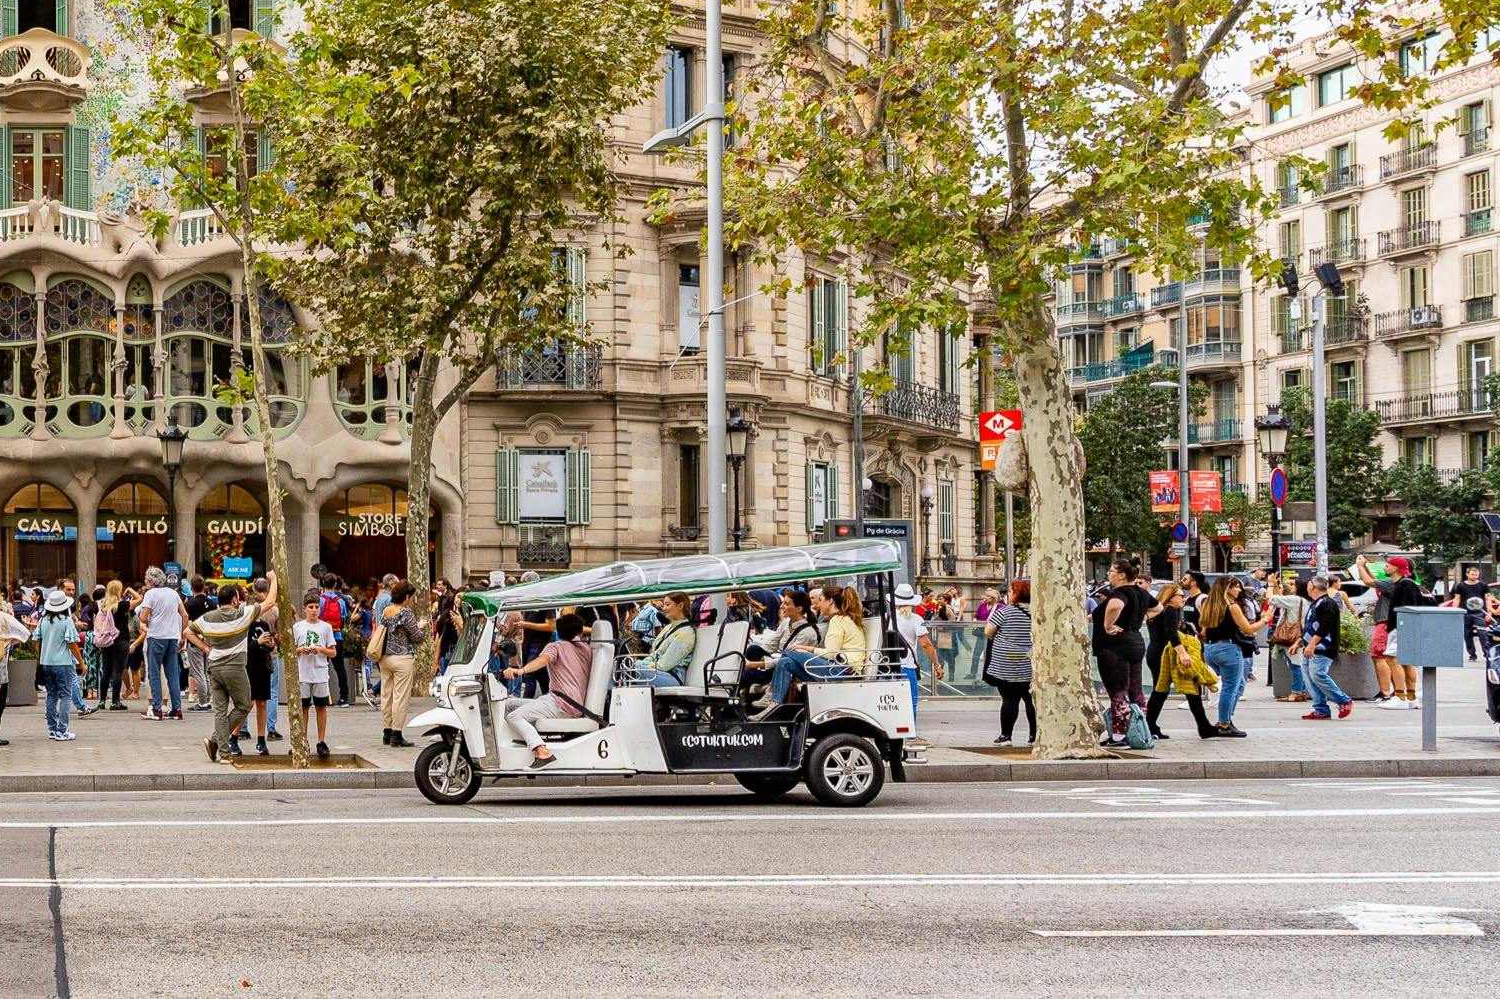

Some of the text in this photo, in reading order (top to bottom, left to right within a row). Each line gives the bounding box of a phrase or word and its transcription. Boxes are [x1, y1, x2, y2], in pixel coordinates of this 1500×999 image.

[17, 516, 263, 535] CASA BATLLÓ GAUDÍ
[358, 512, 403, 524] STORE
[338, 521, 405, 537] SIMBOL
[866, 527, 876, 535] Pg
[597, 739, 609, 759] 6
